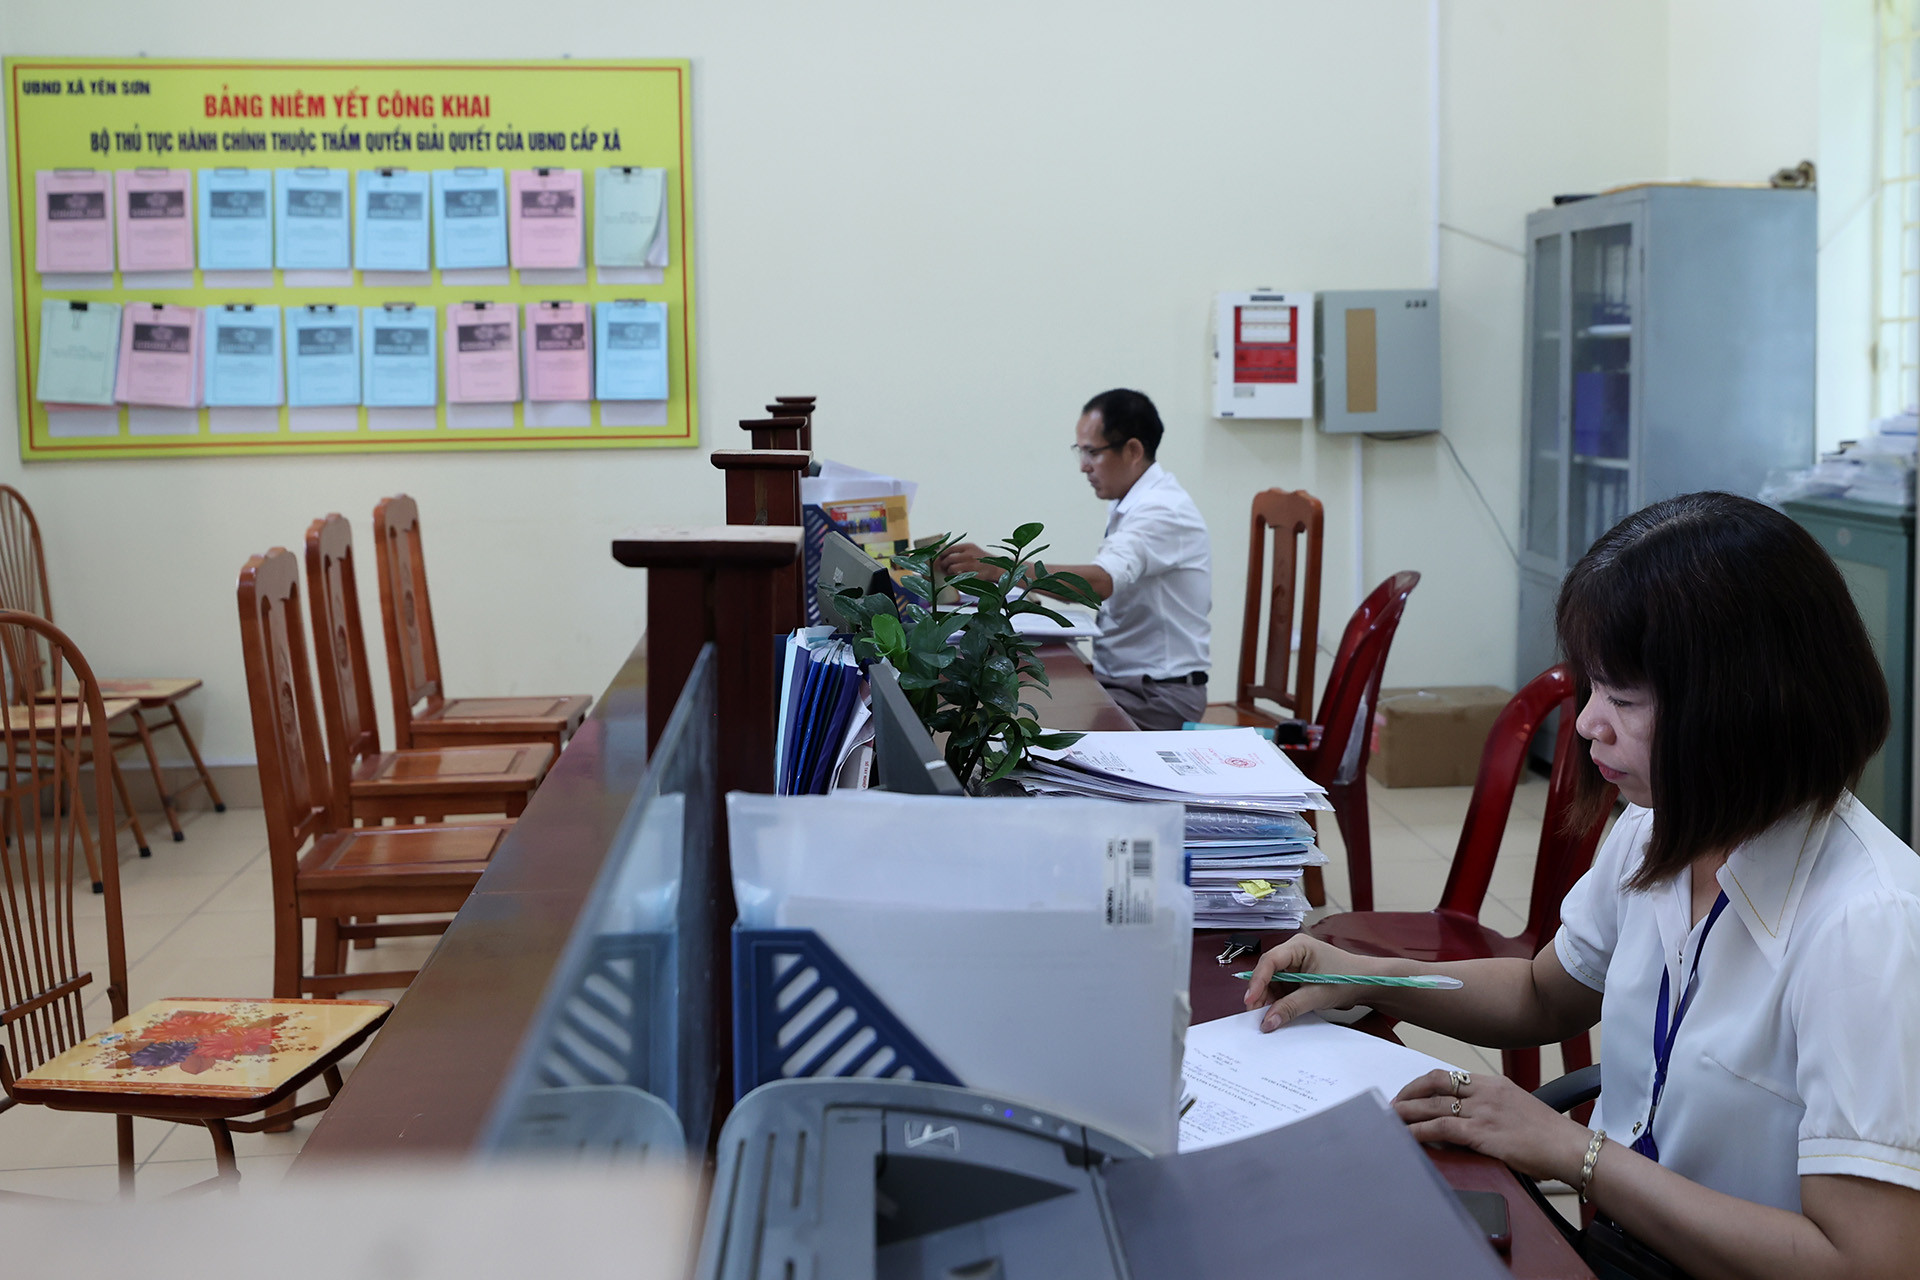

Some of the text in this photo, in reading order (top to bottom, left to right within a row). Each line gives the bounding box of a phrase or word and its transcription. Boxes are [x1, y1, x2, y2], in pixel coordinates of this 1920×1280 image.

[22, 80, 62, 95] UBND
[90, 78, 117, 95] YÊN
[121, 80, 150, 95] SƠN
[204, 83, 490, 118] BẢNG NIÊM YẾT CÔNG KHAI
[90, 126, 110, 156] BỘ
[115, 123, 142, 152] THỦ
[147, 131, 173, 156] TỤC
[178, 127, 217, 152] HÀNH
[222, 127, 266, 152] CHÍNH
[271, 127, 317, 156] THUỘC
[416, 123, 444, 152] GIẢI
[448, 124, 491, 153] QUYẾT
[496, 123, 525, 152] CỦA
[528, 131, 566, 152] UBND
[570, 124, 598, 152] CẤP
